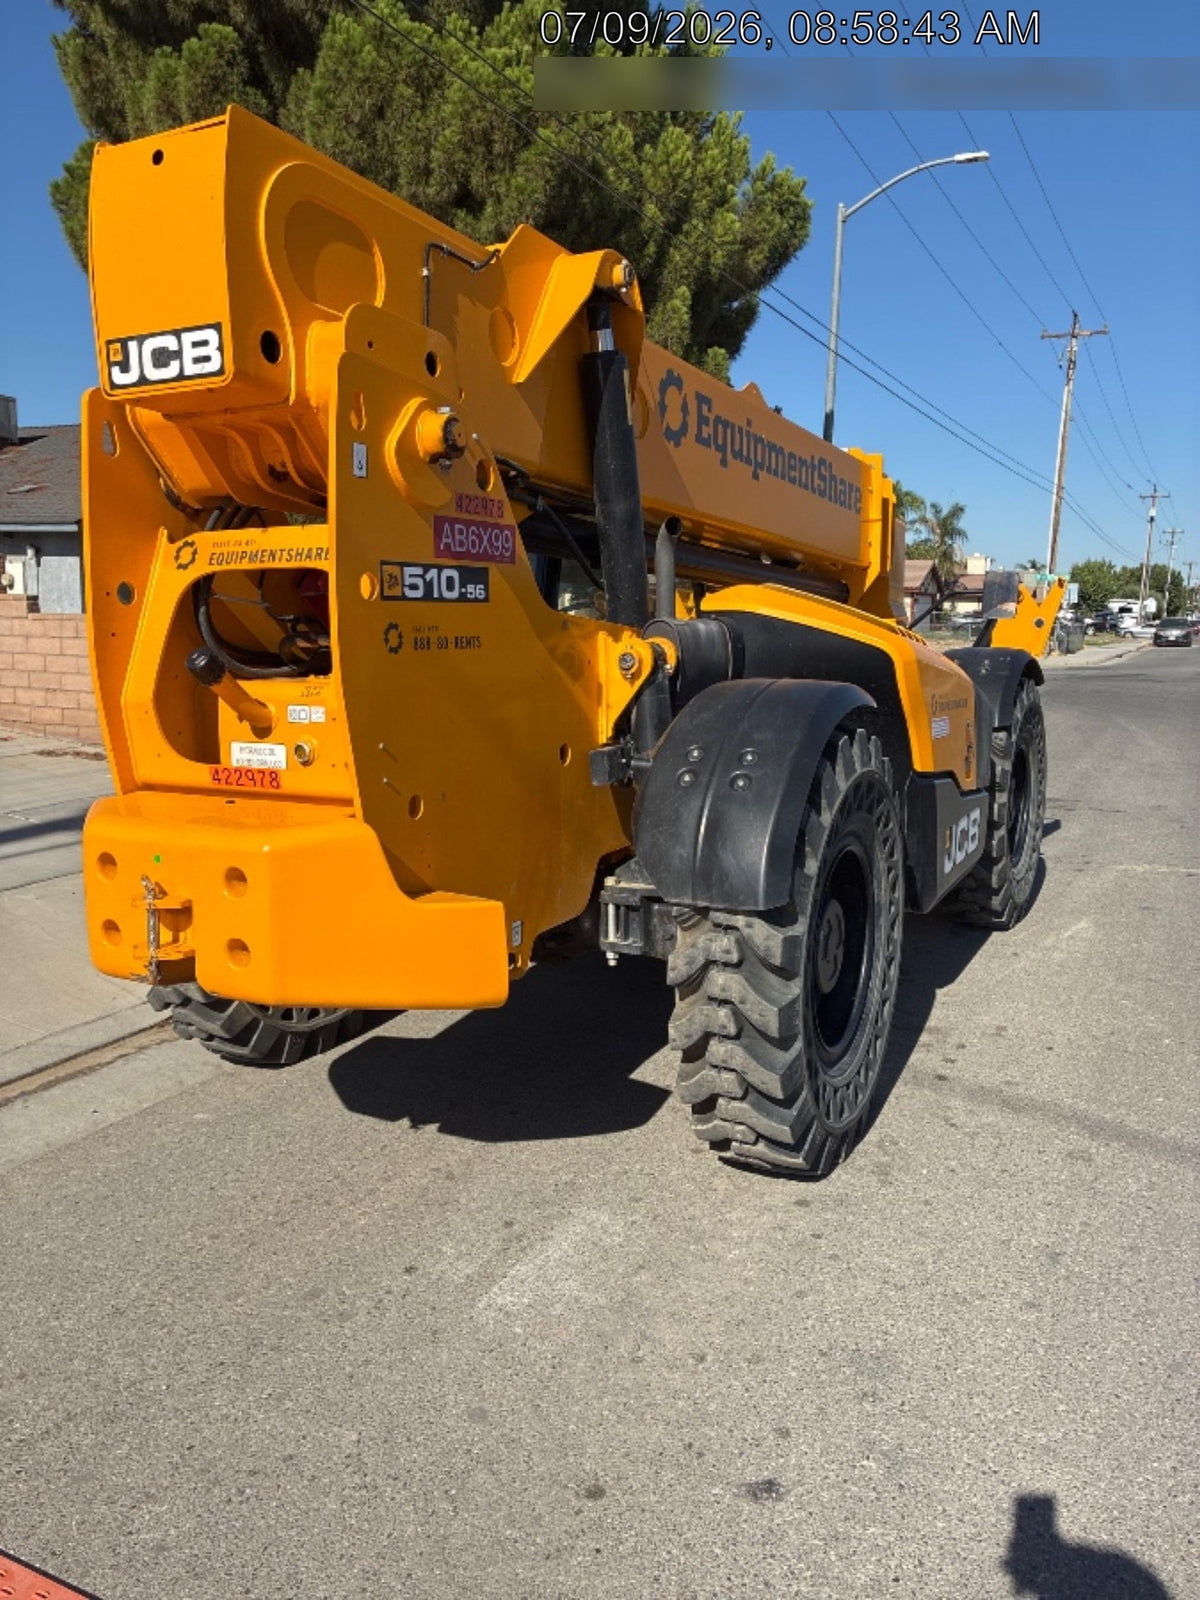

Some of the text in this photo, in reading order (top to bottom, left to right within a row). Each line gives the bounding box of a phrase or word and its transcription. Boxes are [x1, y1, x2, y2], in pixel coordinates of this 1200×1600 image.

[111, 328, 222, 385] JCB
[695, 391, 861, 514] EquipmentShare
[440, 522, 513, 557] AB6X99
[212, 767, 280, 790] 422978
[944, 806, 980, 874] JCB
